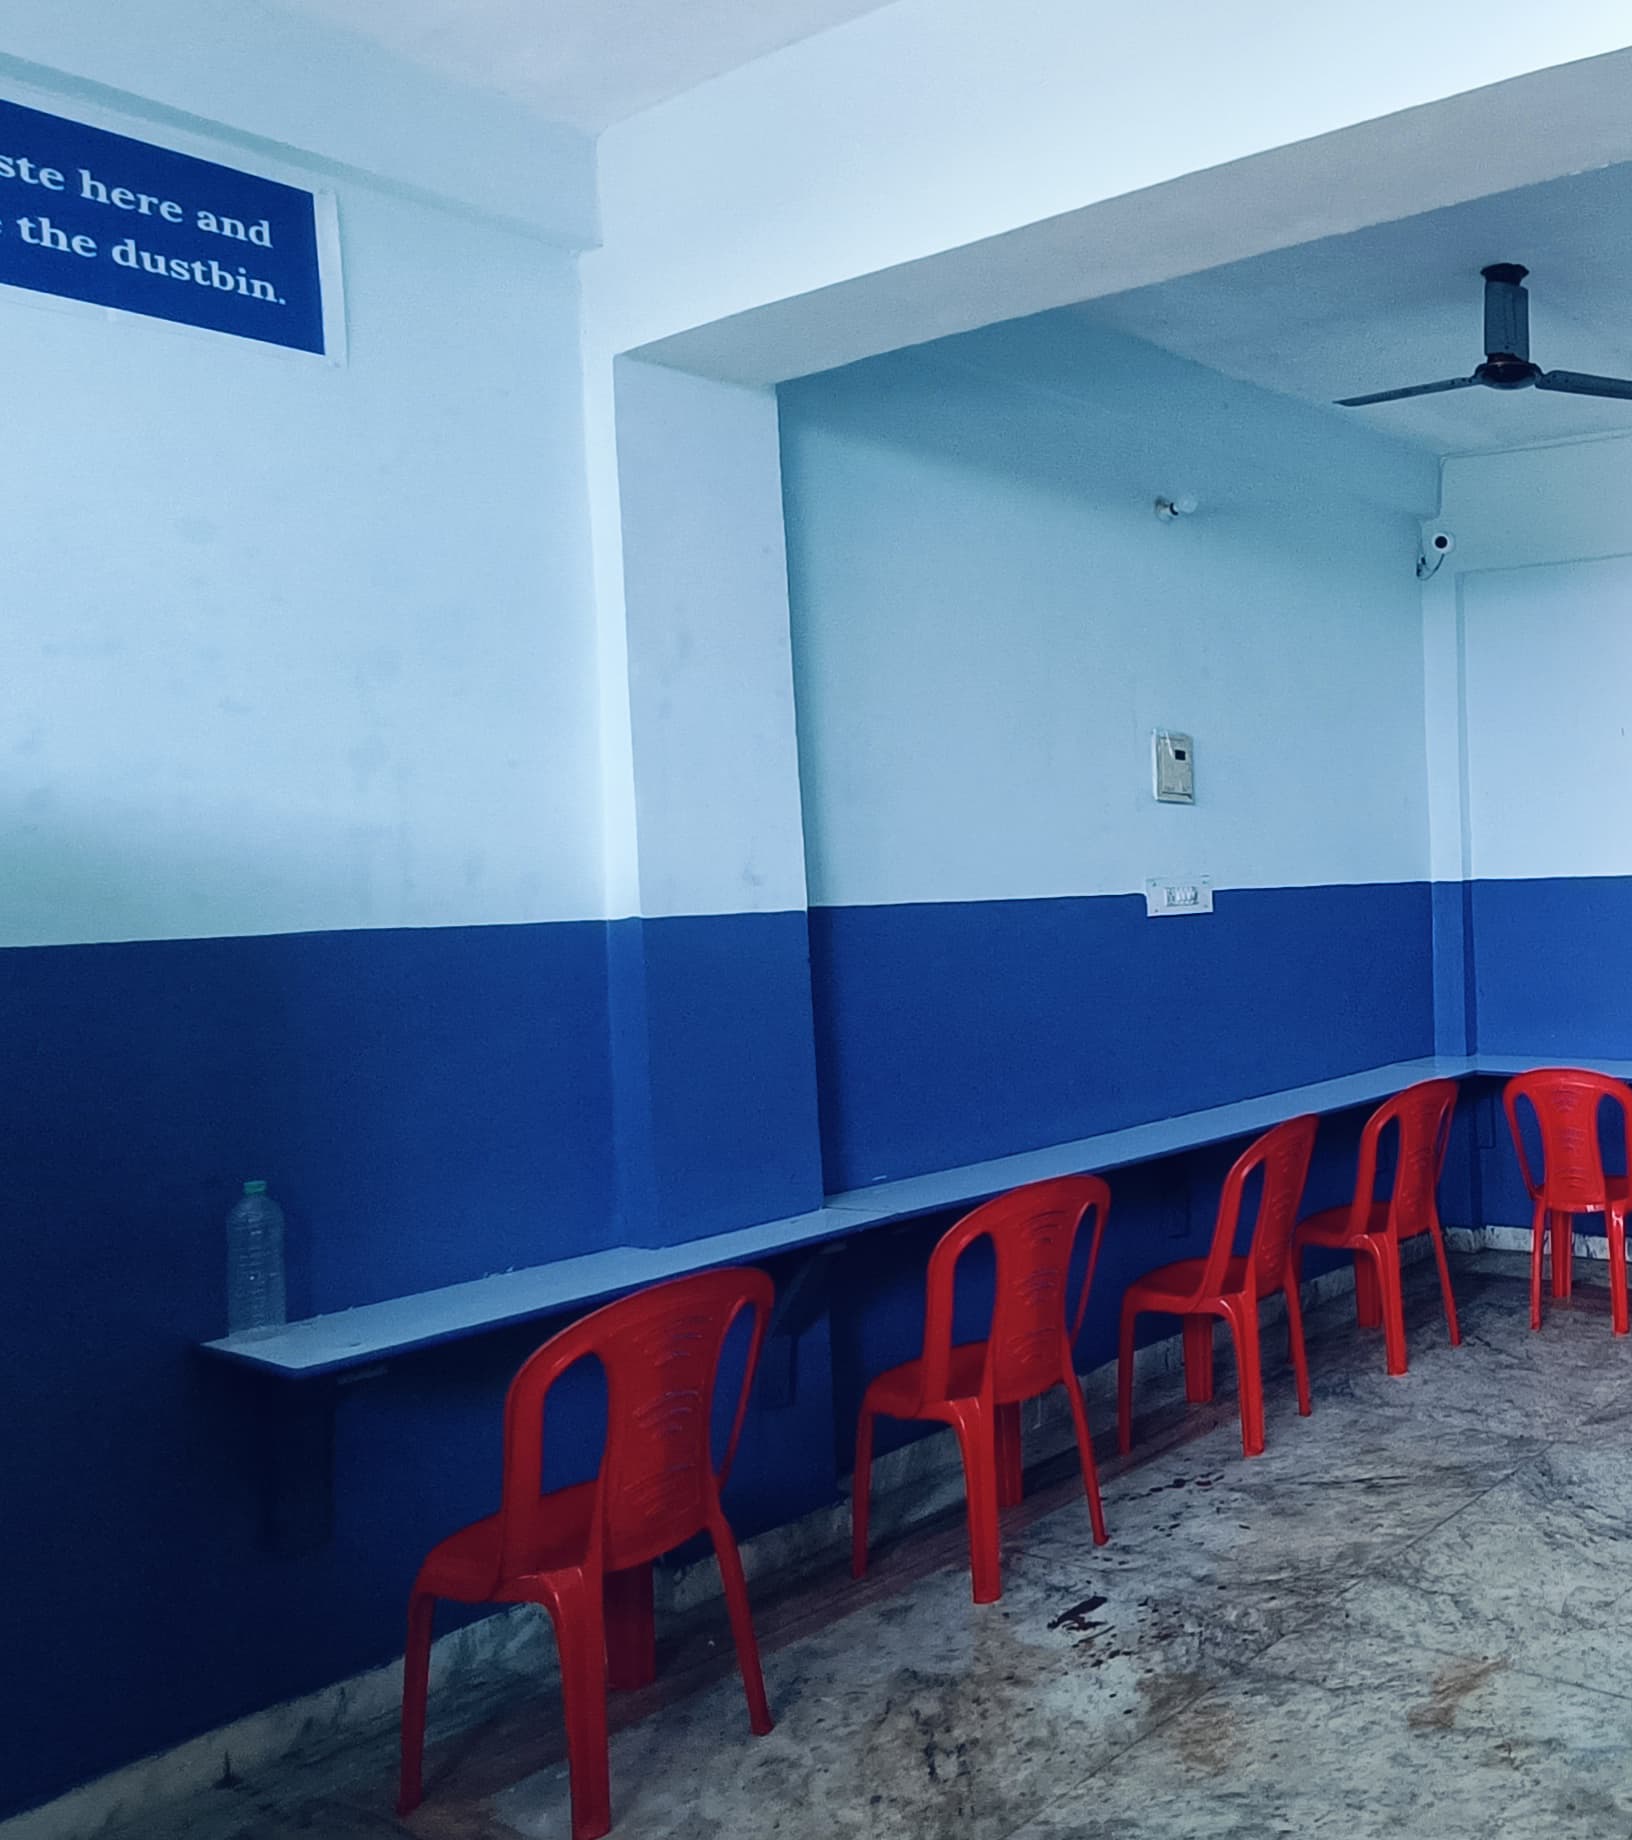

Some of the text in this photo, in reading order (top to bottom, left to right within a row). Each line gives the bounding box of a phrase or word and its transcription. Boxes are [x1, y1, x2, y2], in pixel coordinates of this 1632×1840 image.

[78, 168, 183, 223] here
[197, 209, 273, 248] and
[16, 217, 286, 305] the dustbin.
